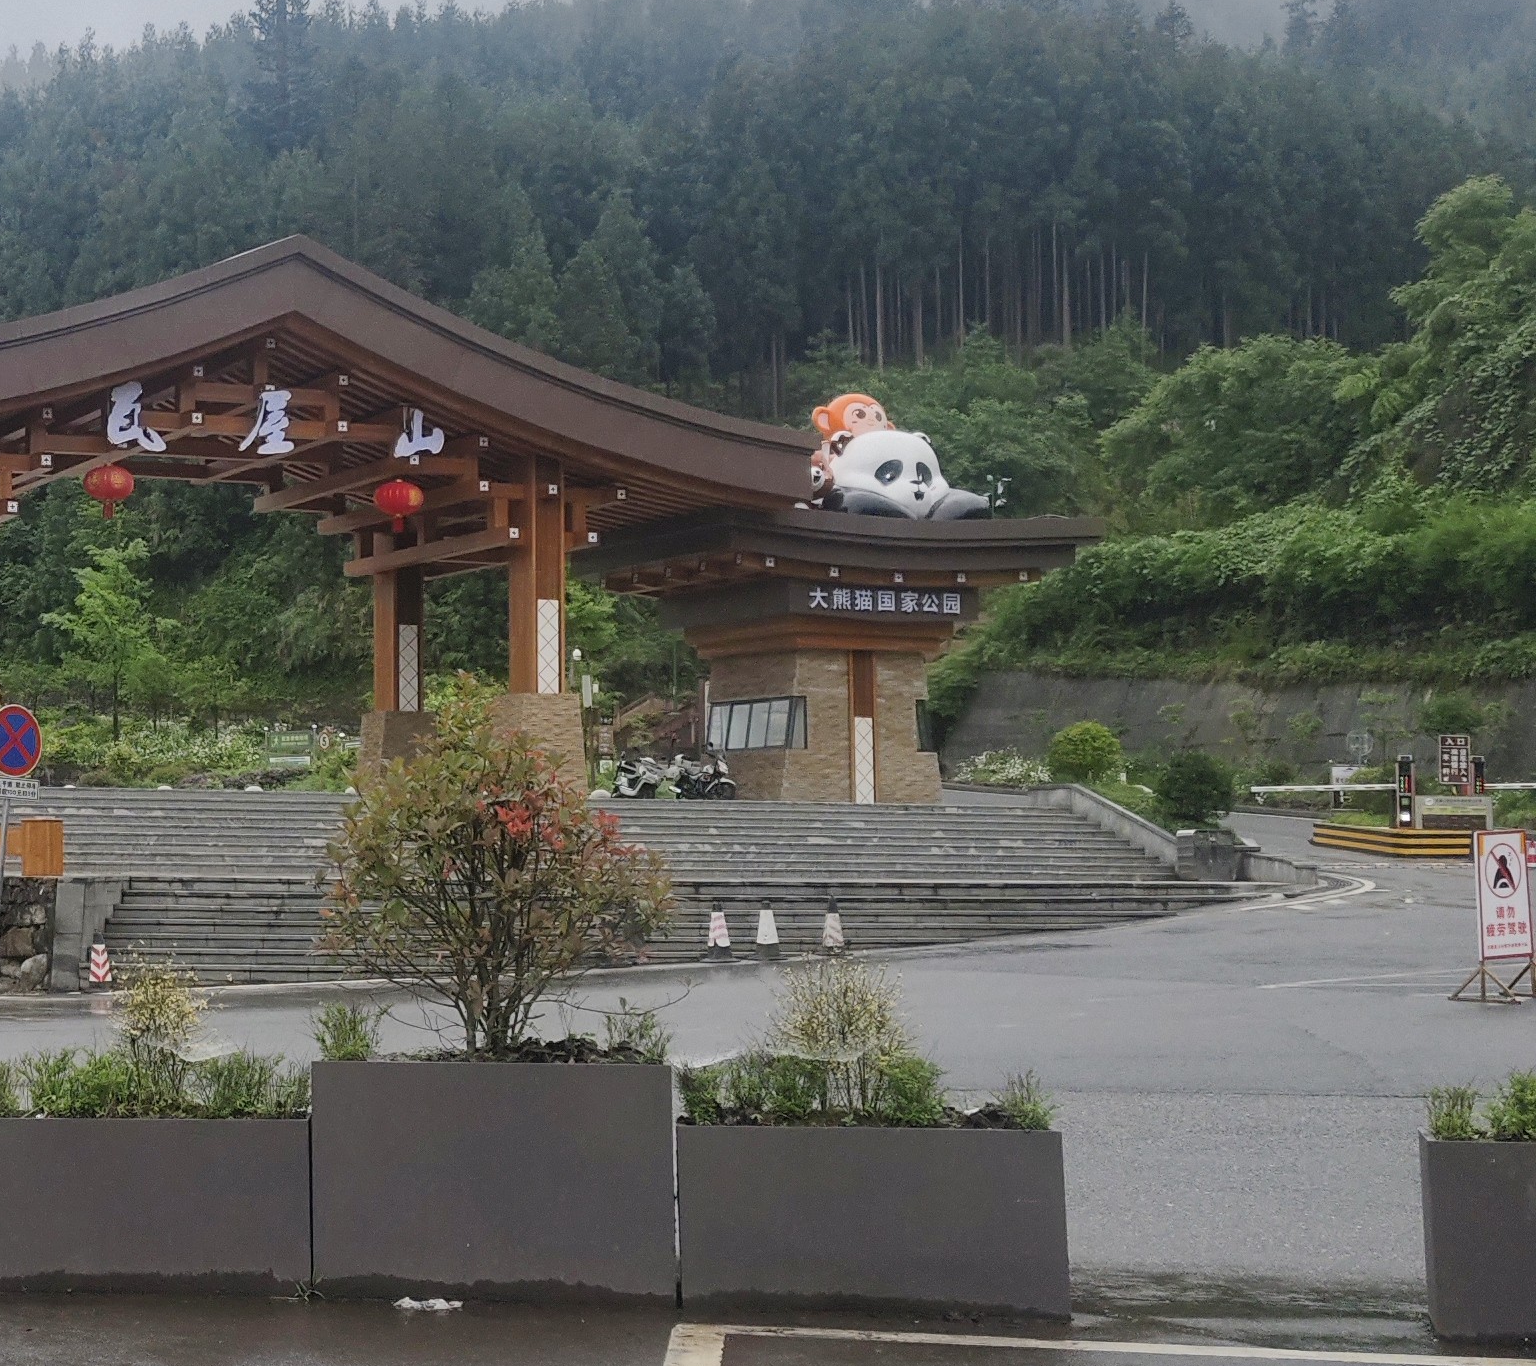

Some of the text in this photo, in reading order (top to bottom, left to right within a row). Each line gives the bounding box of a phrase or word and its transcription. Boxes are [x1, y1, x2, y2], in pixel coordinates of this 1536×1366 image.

[107, 381, 445, 459] 瓦屋山
[809, 587, 961, 615] 大熊猫国家公园
[1444, 737, 1465, 746] 入口
[1495, 905, 1516, 919] 请勿
[1486, 921, 1528, 937] 疲劳驾驶
